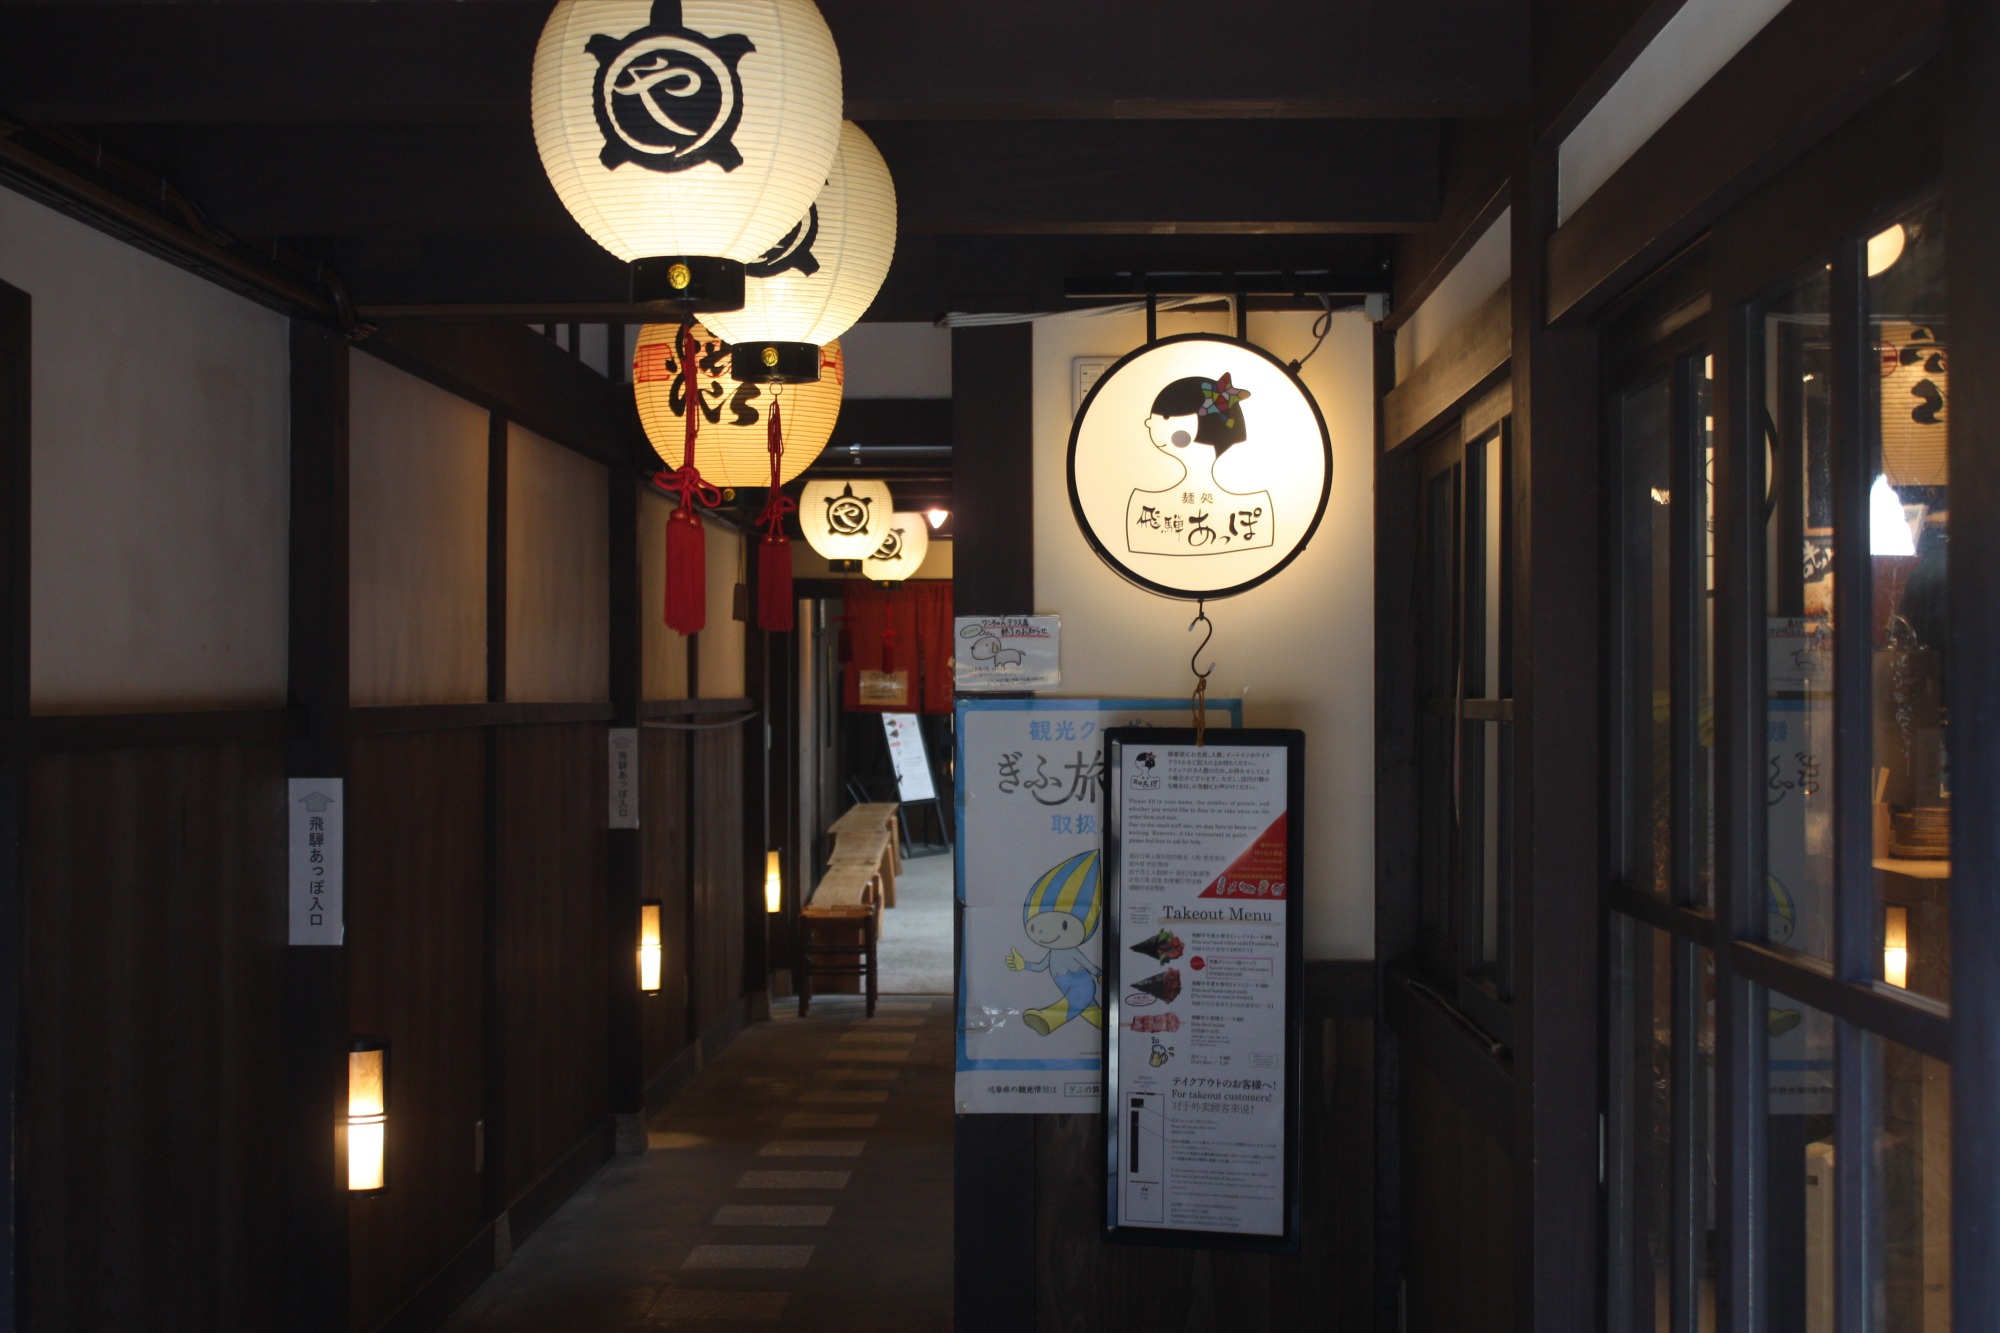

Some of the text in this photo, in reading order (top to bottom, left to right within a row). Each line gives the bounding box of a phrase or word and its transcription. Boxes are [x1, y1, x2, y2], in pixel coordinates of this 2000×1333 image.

[1136, 505, 1262, 547] 飛騨あっぽ
[1000, 627, 1049, 637] 終了のお知らせ
[618, 751, 628, 817] 飛騨あっぽ入口
[308, 816, 325, 927] 飛騨あっぽ入口
[1162, 905, 1225, 921] Takeout
[1229, 907, 1273, 922] Menu
[1172, 1076, 1277, 1091] テイクアウトのお客様へ！
[1171, 1089, 1272, 1103] For takeout customers!
